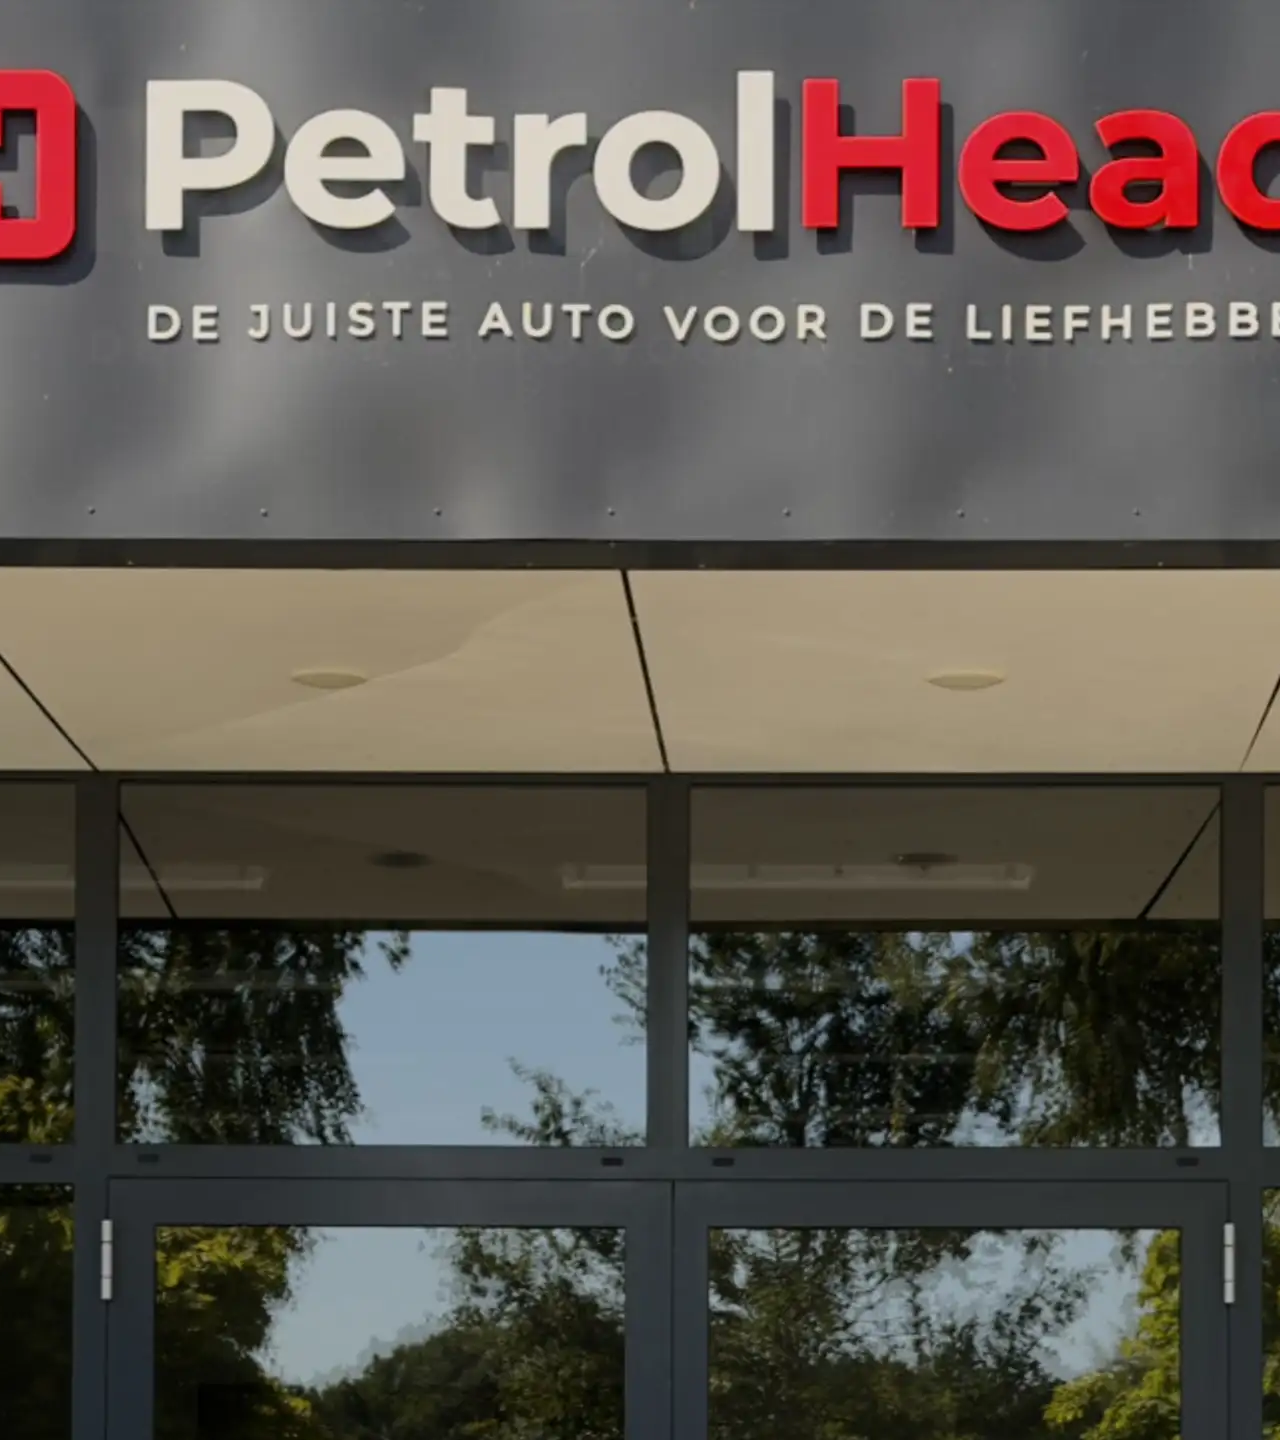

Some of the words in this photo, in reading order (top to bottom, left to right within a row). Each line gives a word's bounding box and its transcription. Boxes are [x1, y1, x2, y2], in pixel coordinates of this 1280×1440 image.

[146, 302, 219, 341] DE
[245, 301, 449, 340] JUISTE
[477, 302, 635, 340] AUTO
[663, 303, 827, 342] VOOR
[859, 302, 932, 339] DE
